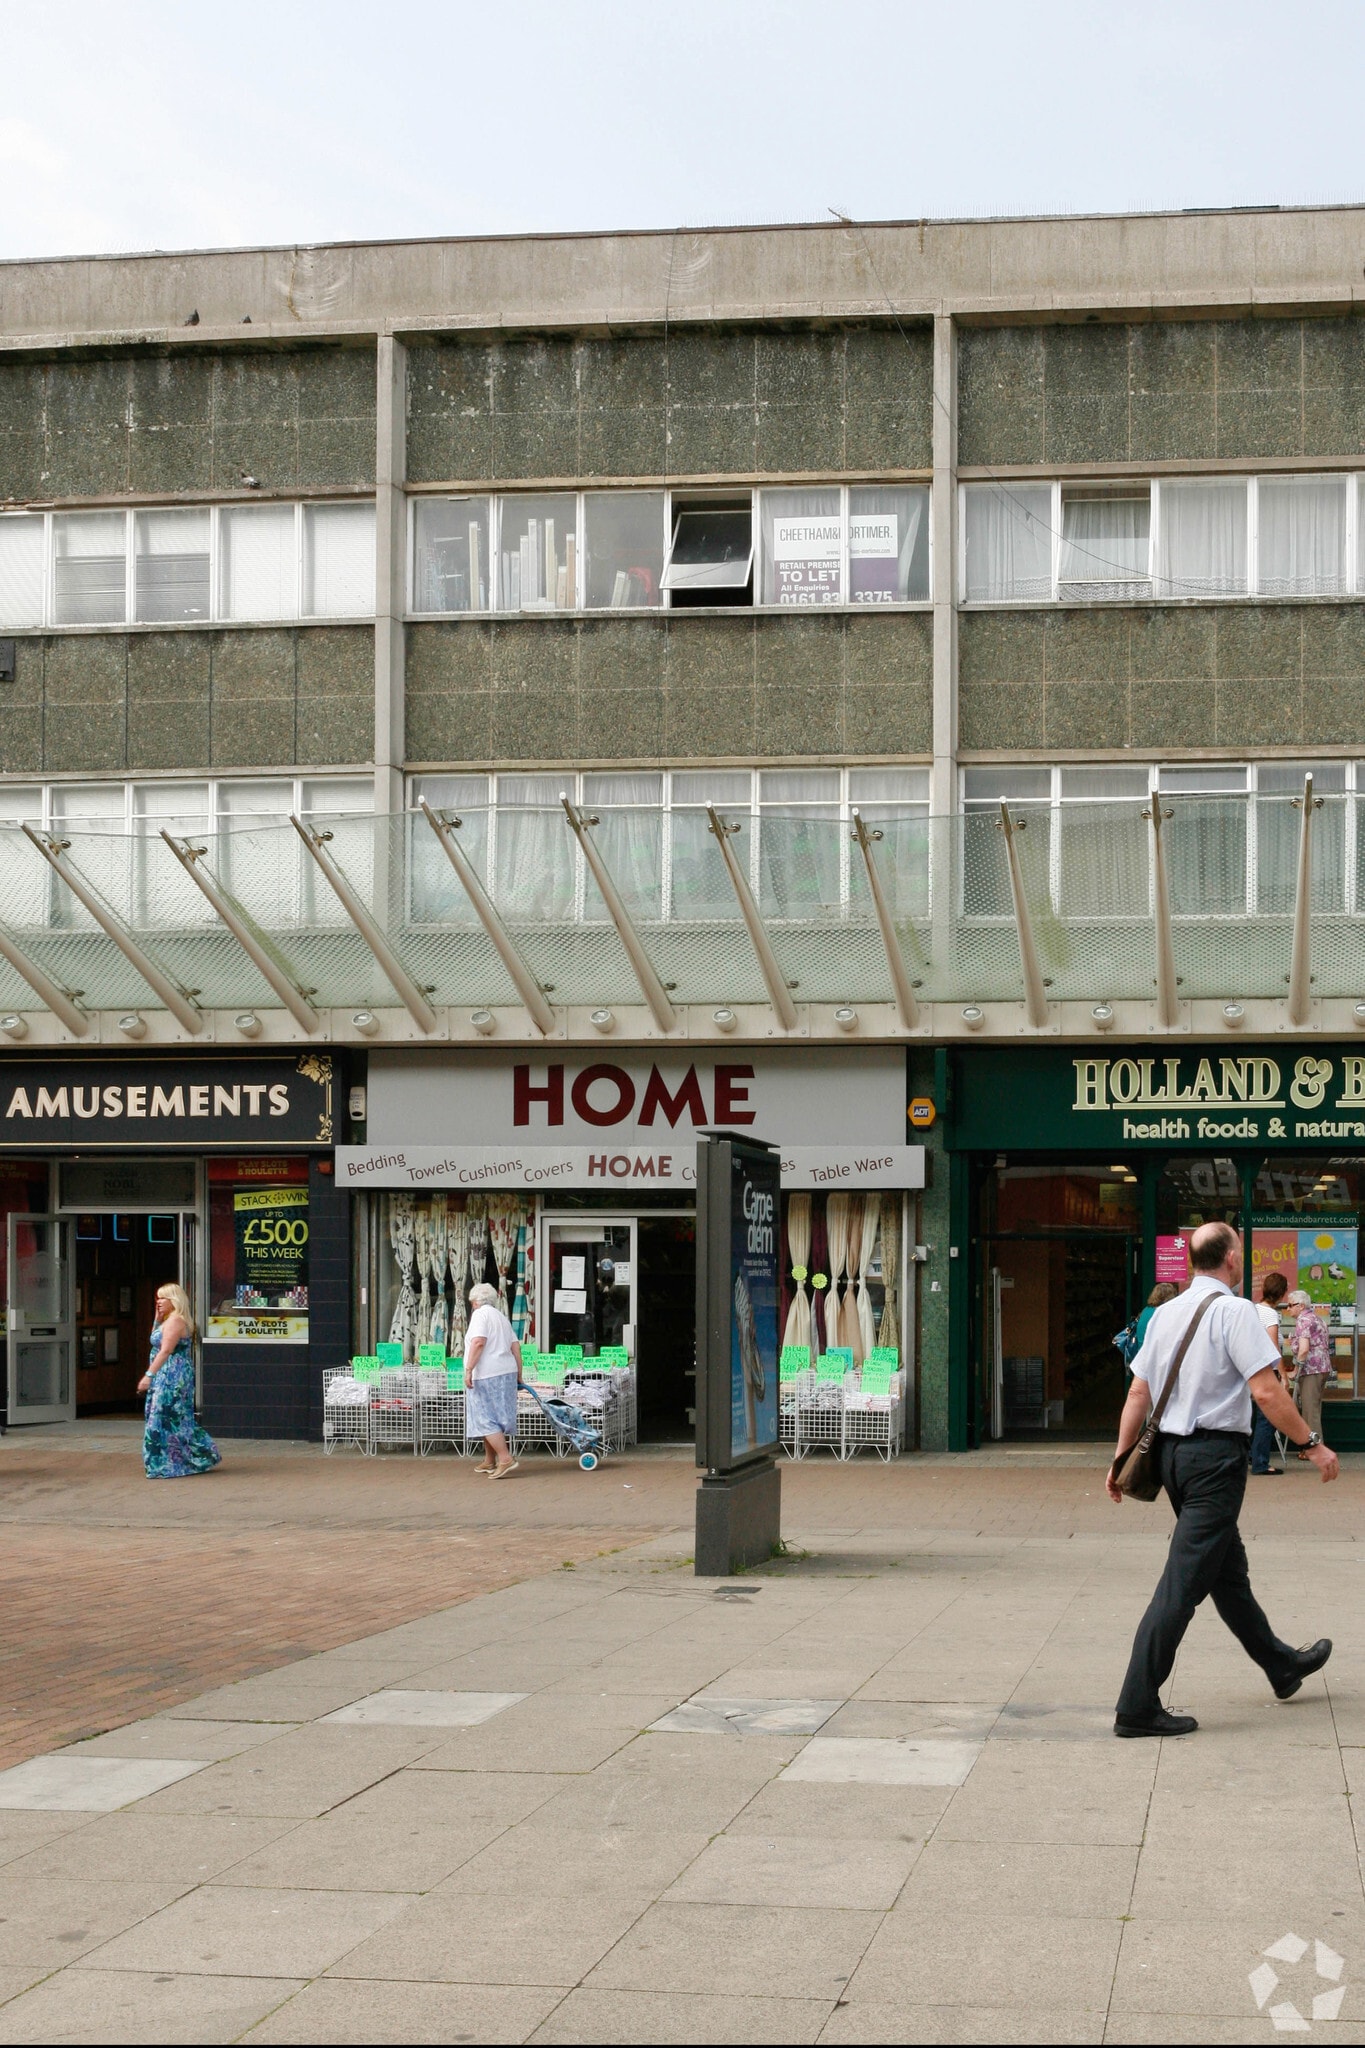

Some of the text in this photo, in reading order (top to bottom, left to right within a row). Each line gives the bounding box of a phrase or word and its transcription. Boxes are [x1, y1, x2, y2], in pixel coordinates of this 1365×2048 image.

[780, 560, 841, 570] RETAIL PREMISE
[780, 570, 839, 582] TO LET
[780, 593, 816, 604] 0161
[793, 584, 830, 592] Enquiries
[1072, 1058, 1282, 1110] HOLLAND
[1289, 1056, 1333, 1109] &
[5, 1084, 290, 1119] AMUSEMENTS
[513, 1062, 757, 1129] HOME
[914, 1108, 929, 1116] ADT
[1123, 1118, 1190, 1139] health
[1197, 1117, 1259, 1138] foods
[1267, 1117, 1287, 1138] &
[238, 1160, 288, 1168] PLAY SLOTS
[346, 1152, 574, 1183] Bedding Towels Cushions Covers
[587, 1154, 672, 1178] HOME
[809, 1155, 894, 1183] Table Ware
[241, 1192, 308, 1206] STACK WIN
[742, 1181, 773, 1226] Carpe
[243, 1219, 309, 1245] £500
[244, 1247, 304, 1259] THIS WEEK
[1271, 1242, 1296, 1263] off
[238, 1320, 288, 1328] PLAY SLOTS
